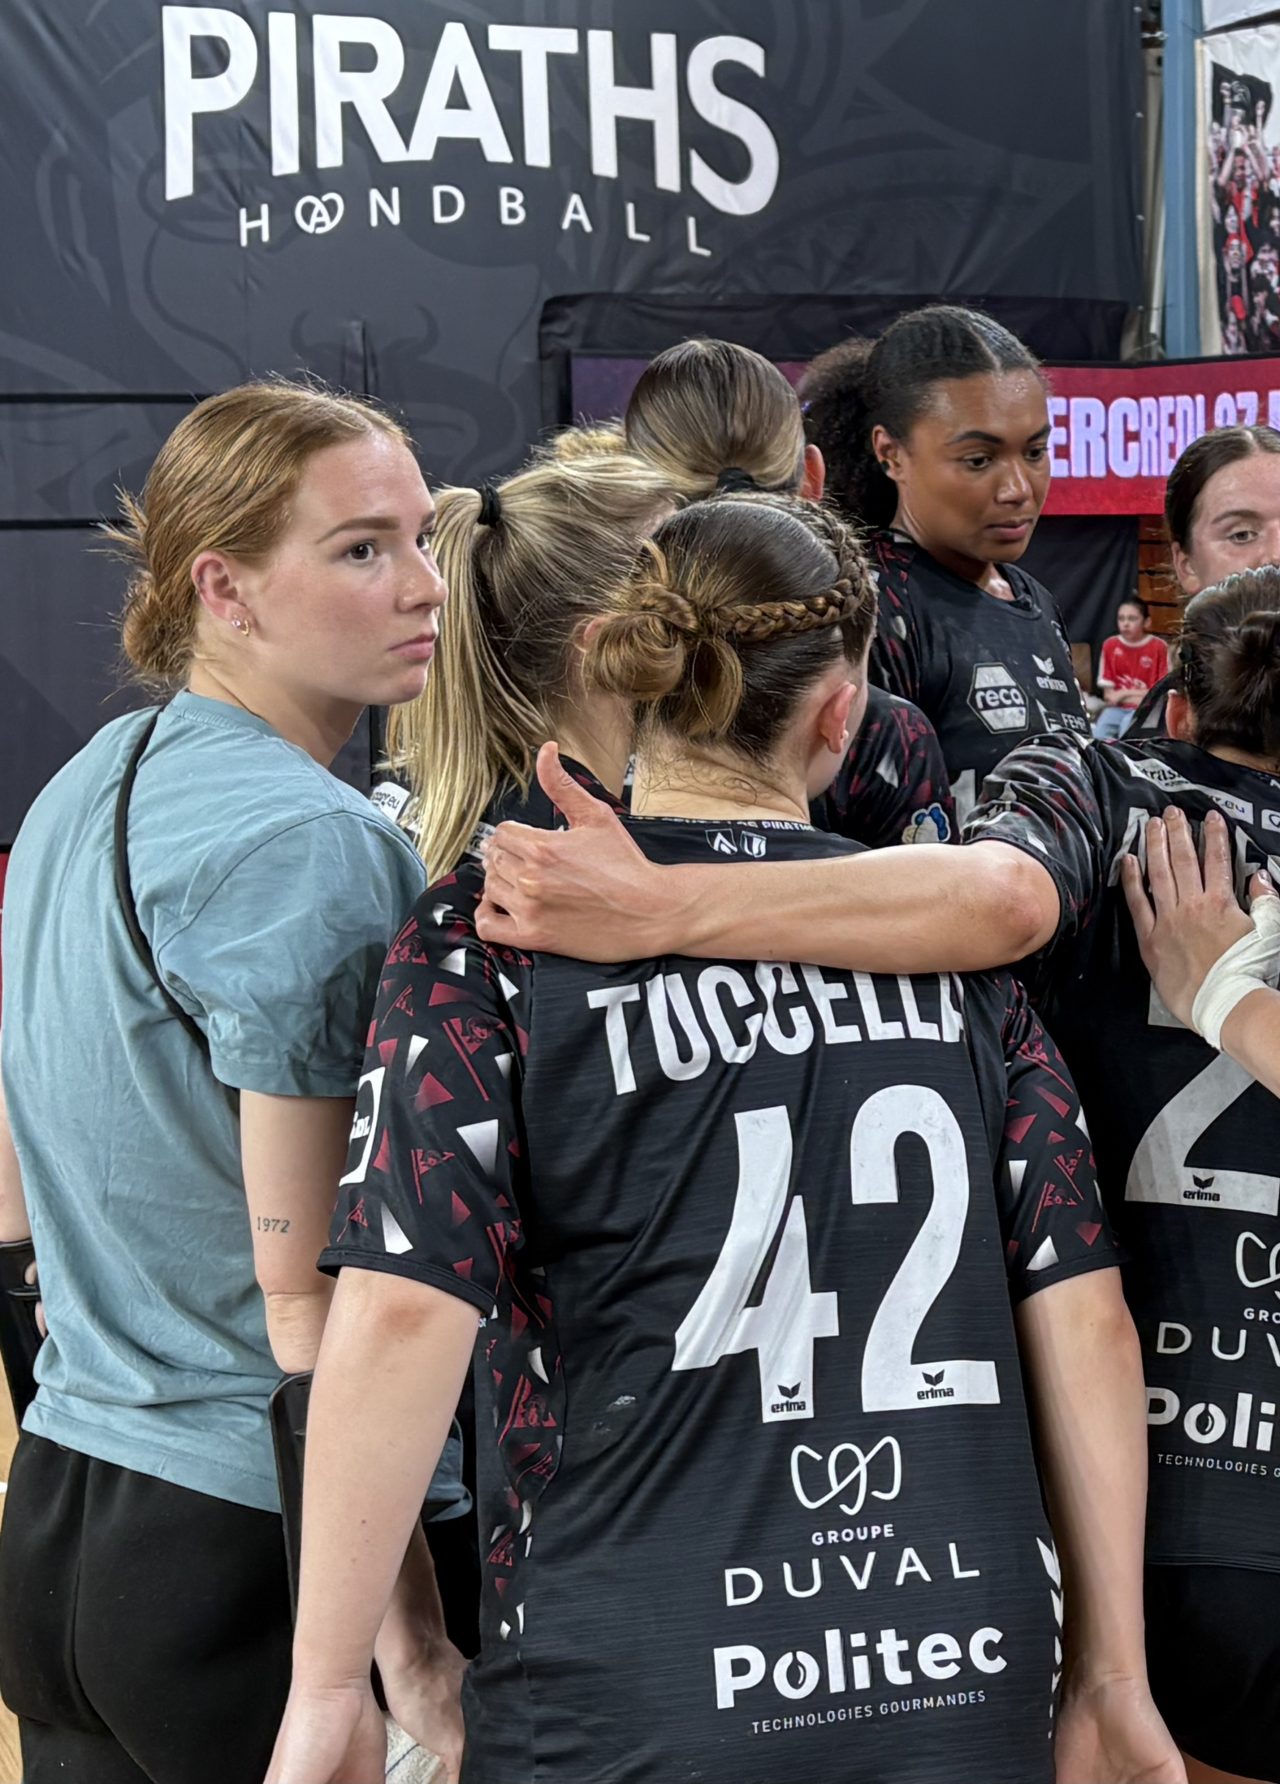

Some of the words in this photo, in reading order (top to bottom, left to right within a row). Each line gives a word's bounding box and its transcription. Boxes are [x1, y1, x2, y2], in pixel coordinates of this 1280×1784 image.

[161, 5, 780, 216] PIRATHS
[239, 185, 711, 256] HANDBALL
[1048, 394, 1205, 478] ERCREDI
[1183, 1190, 1220, 1202] erima
[257, 1216, 290, 1233] 1972
[671, 1084, 1000, 1424] 42
[771, 1400, 806, 1414] erima
[917, 1386, 954, 1400] erima
[1157, 1454, 1268, 1476] TECHNOLOGIES
[811, 1523, 895, 1545] GROUPE
[724, 1543, 980, 1607] DUVAL
[713, 1627, 1008, 1709] Politec
[751, 1705, 874, 1734] TECHNOLOGIES
[879, 1690, 987, 1716] GOURMANDES
